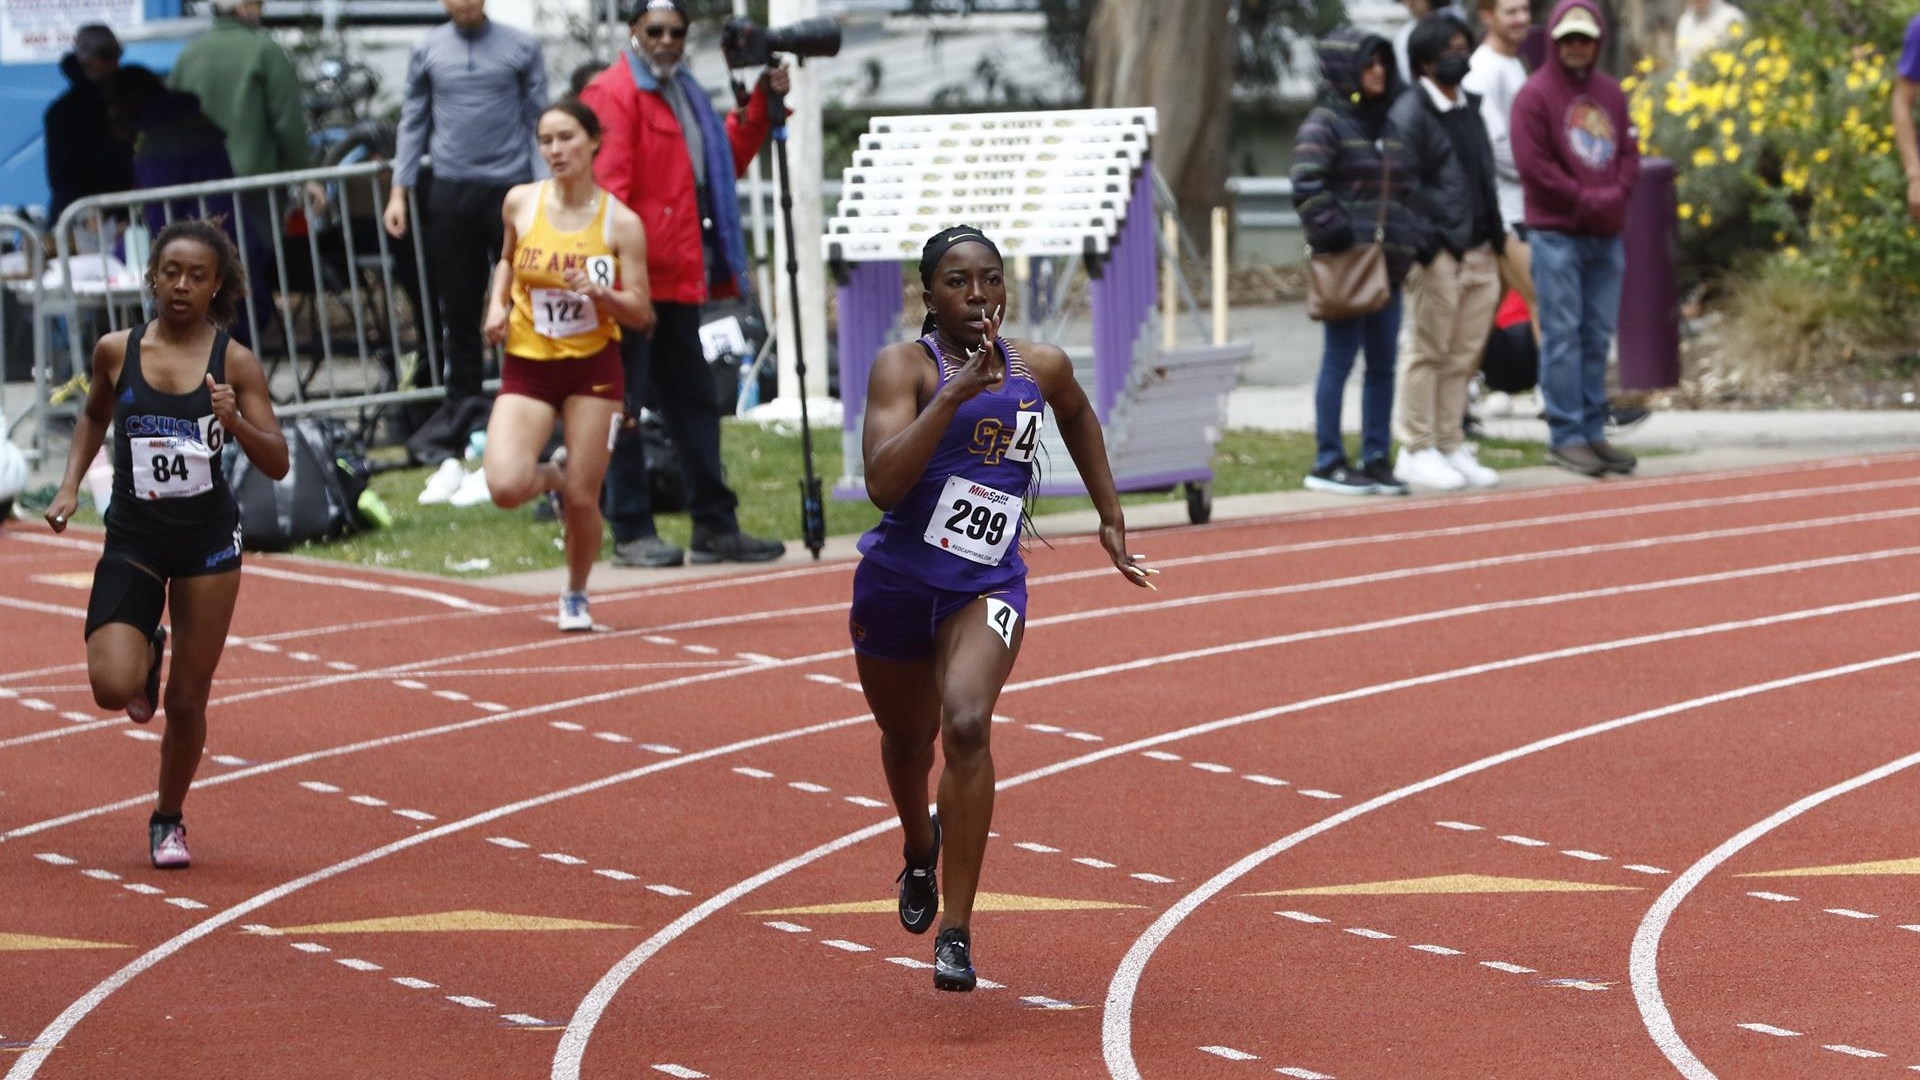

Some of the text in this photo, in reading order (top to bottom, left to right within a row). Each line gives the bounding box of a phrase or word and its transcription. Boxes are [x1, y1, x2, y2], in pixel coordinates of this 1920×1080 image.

[520, 247, 543, 271] DE
[594, 260, 609, 286] 8
[543, 301, 586, 323] 122
[207, 415, 220, 452] 6
[1015, 415, 1038, 460] 4
[152, 453, 189, 483] 84
[968, 484, 1010, 506] MileSplit
[944, 498, 1008, 546] 299
[994, 605, 1011, 638] 4
